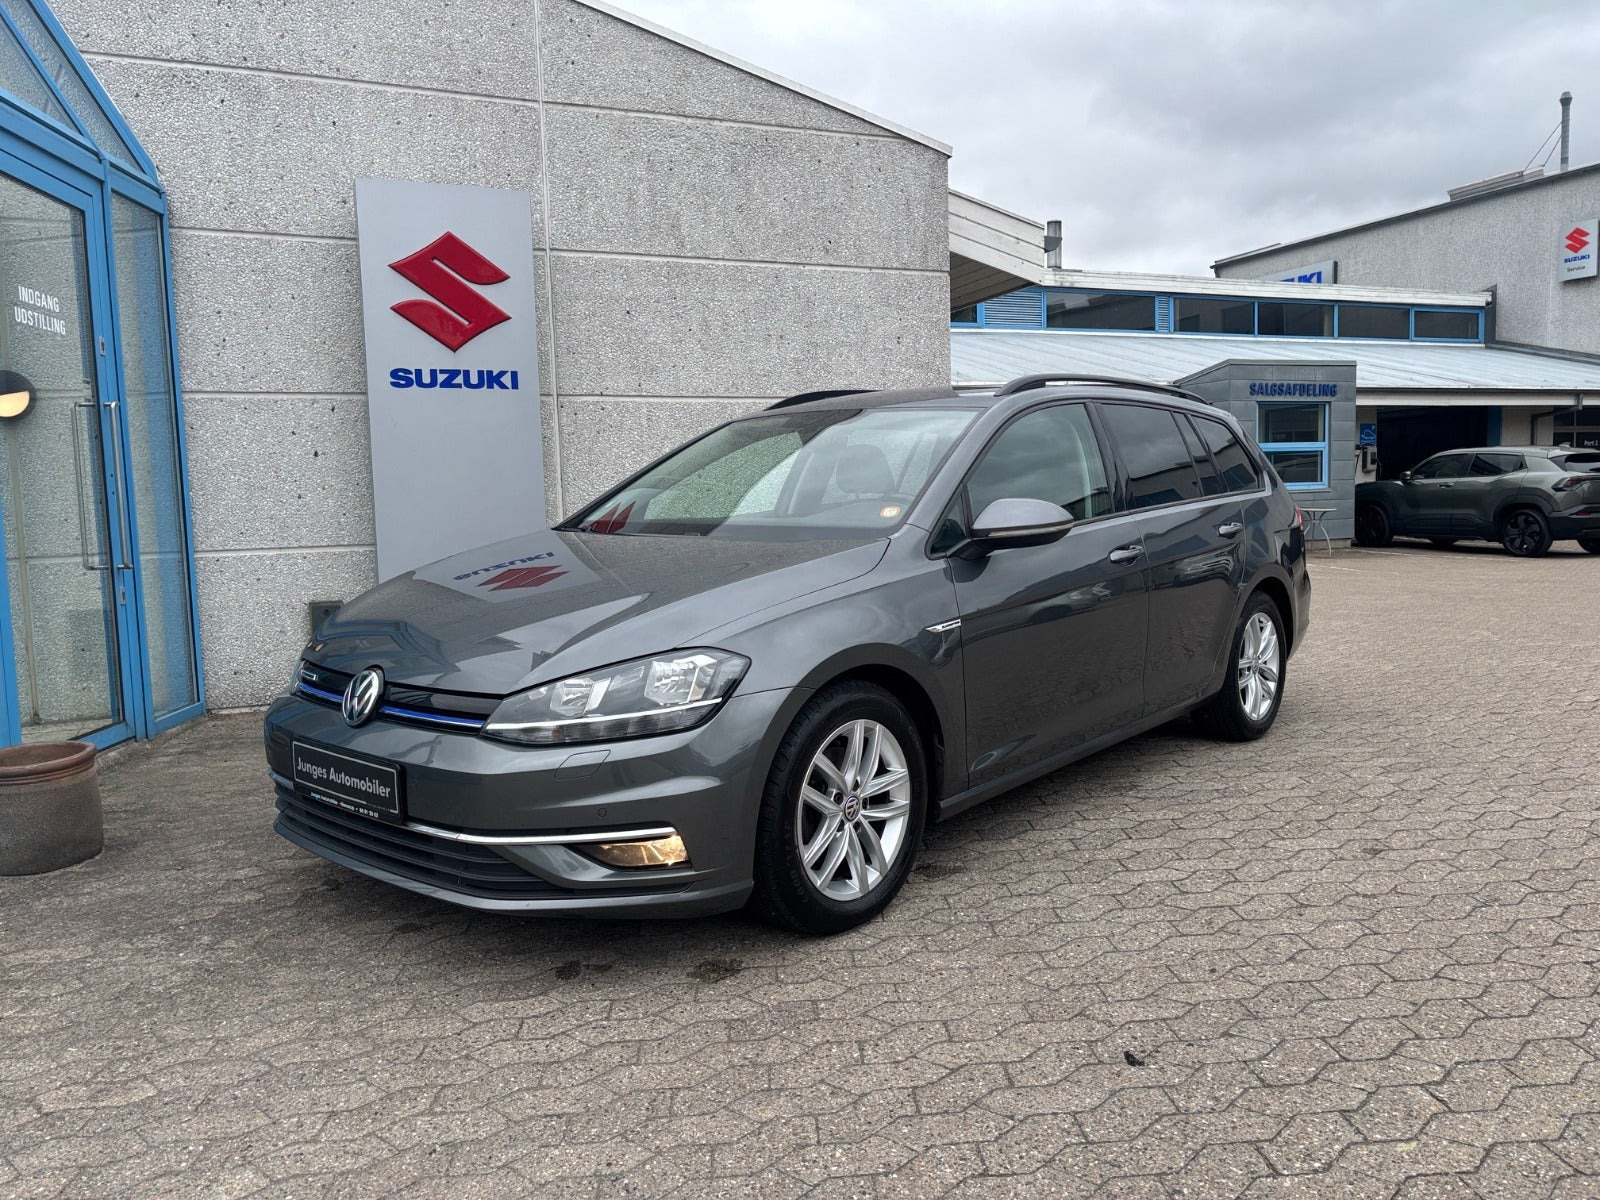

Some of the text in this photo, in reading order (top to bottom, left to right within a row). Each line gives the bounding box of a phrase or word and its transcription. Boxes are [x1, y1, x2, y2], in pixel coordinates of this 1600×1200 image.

[1564, 254, 1590, 263] SUZUKI
[18, 286, 60, 312] INDGANG
[14, 306, 66, 335] UDSTILLING
[389, 367, 519, 390] SUZUKI
[1249, 382, 1338, 397] SALGSAFDELING
[297, 757, 391, 798] Junges Automobiler
